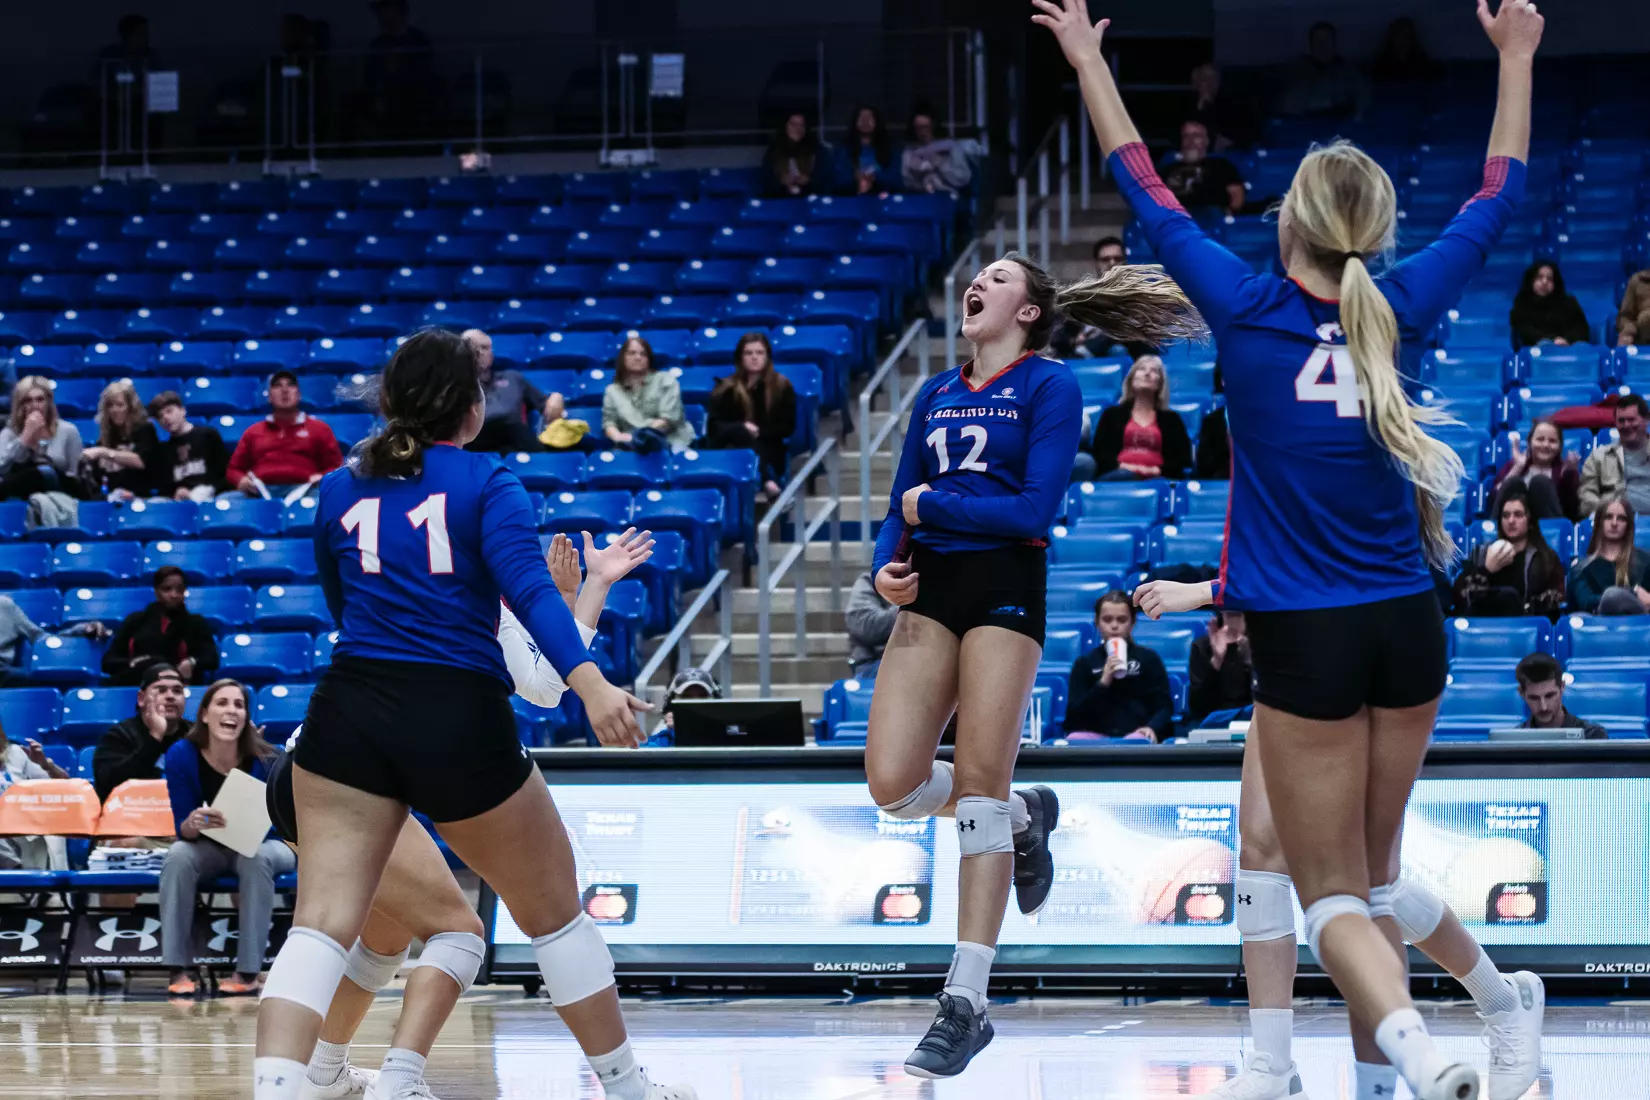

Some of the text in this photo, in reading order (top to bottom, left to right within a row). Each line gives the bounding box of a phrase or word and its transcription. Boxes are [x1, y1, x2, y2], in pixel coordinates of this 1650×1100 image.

[1294, 342, 1364, 418] 4
[926, 424, 988, 474] 12
[340, 492, 455, 574] 11
[80, 956, 118, 964] UNDER
[192, 956, 230, 964] UNDER
[814, 962, 906, 972] DAKTRONICS
